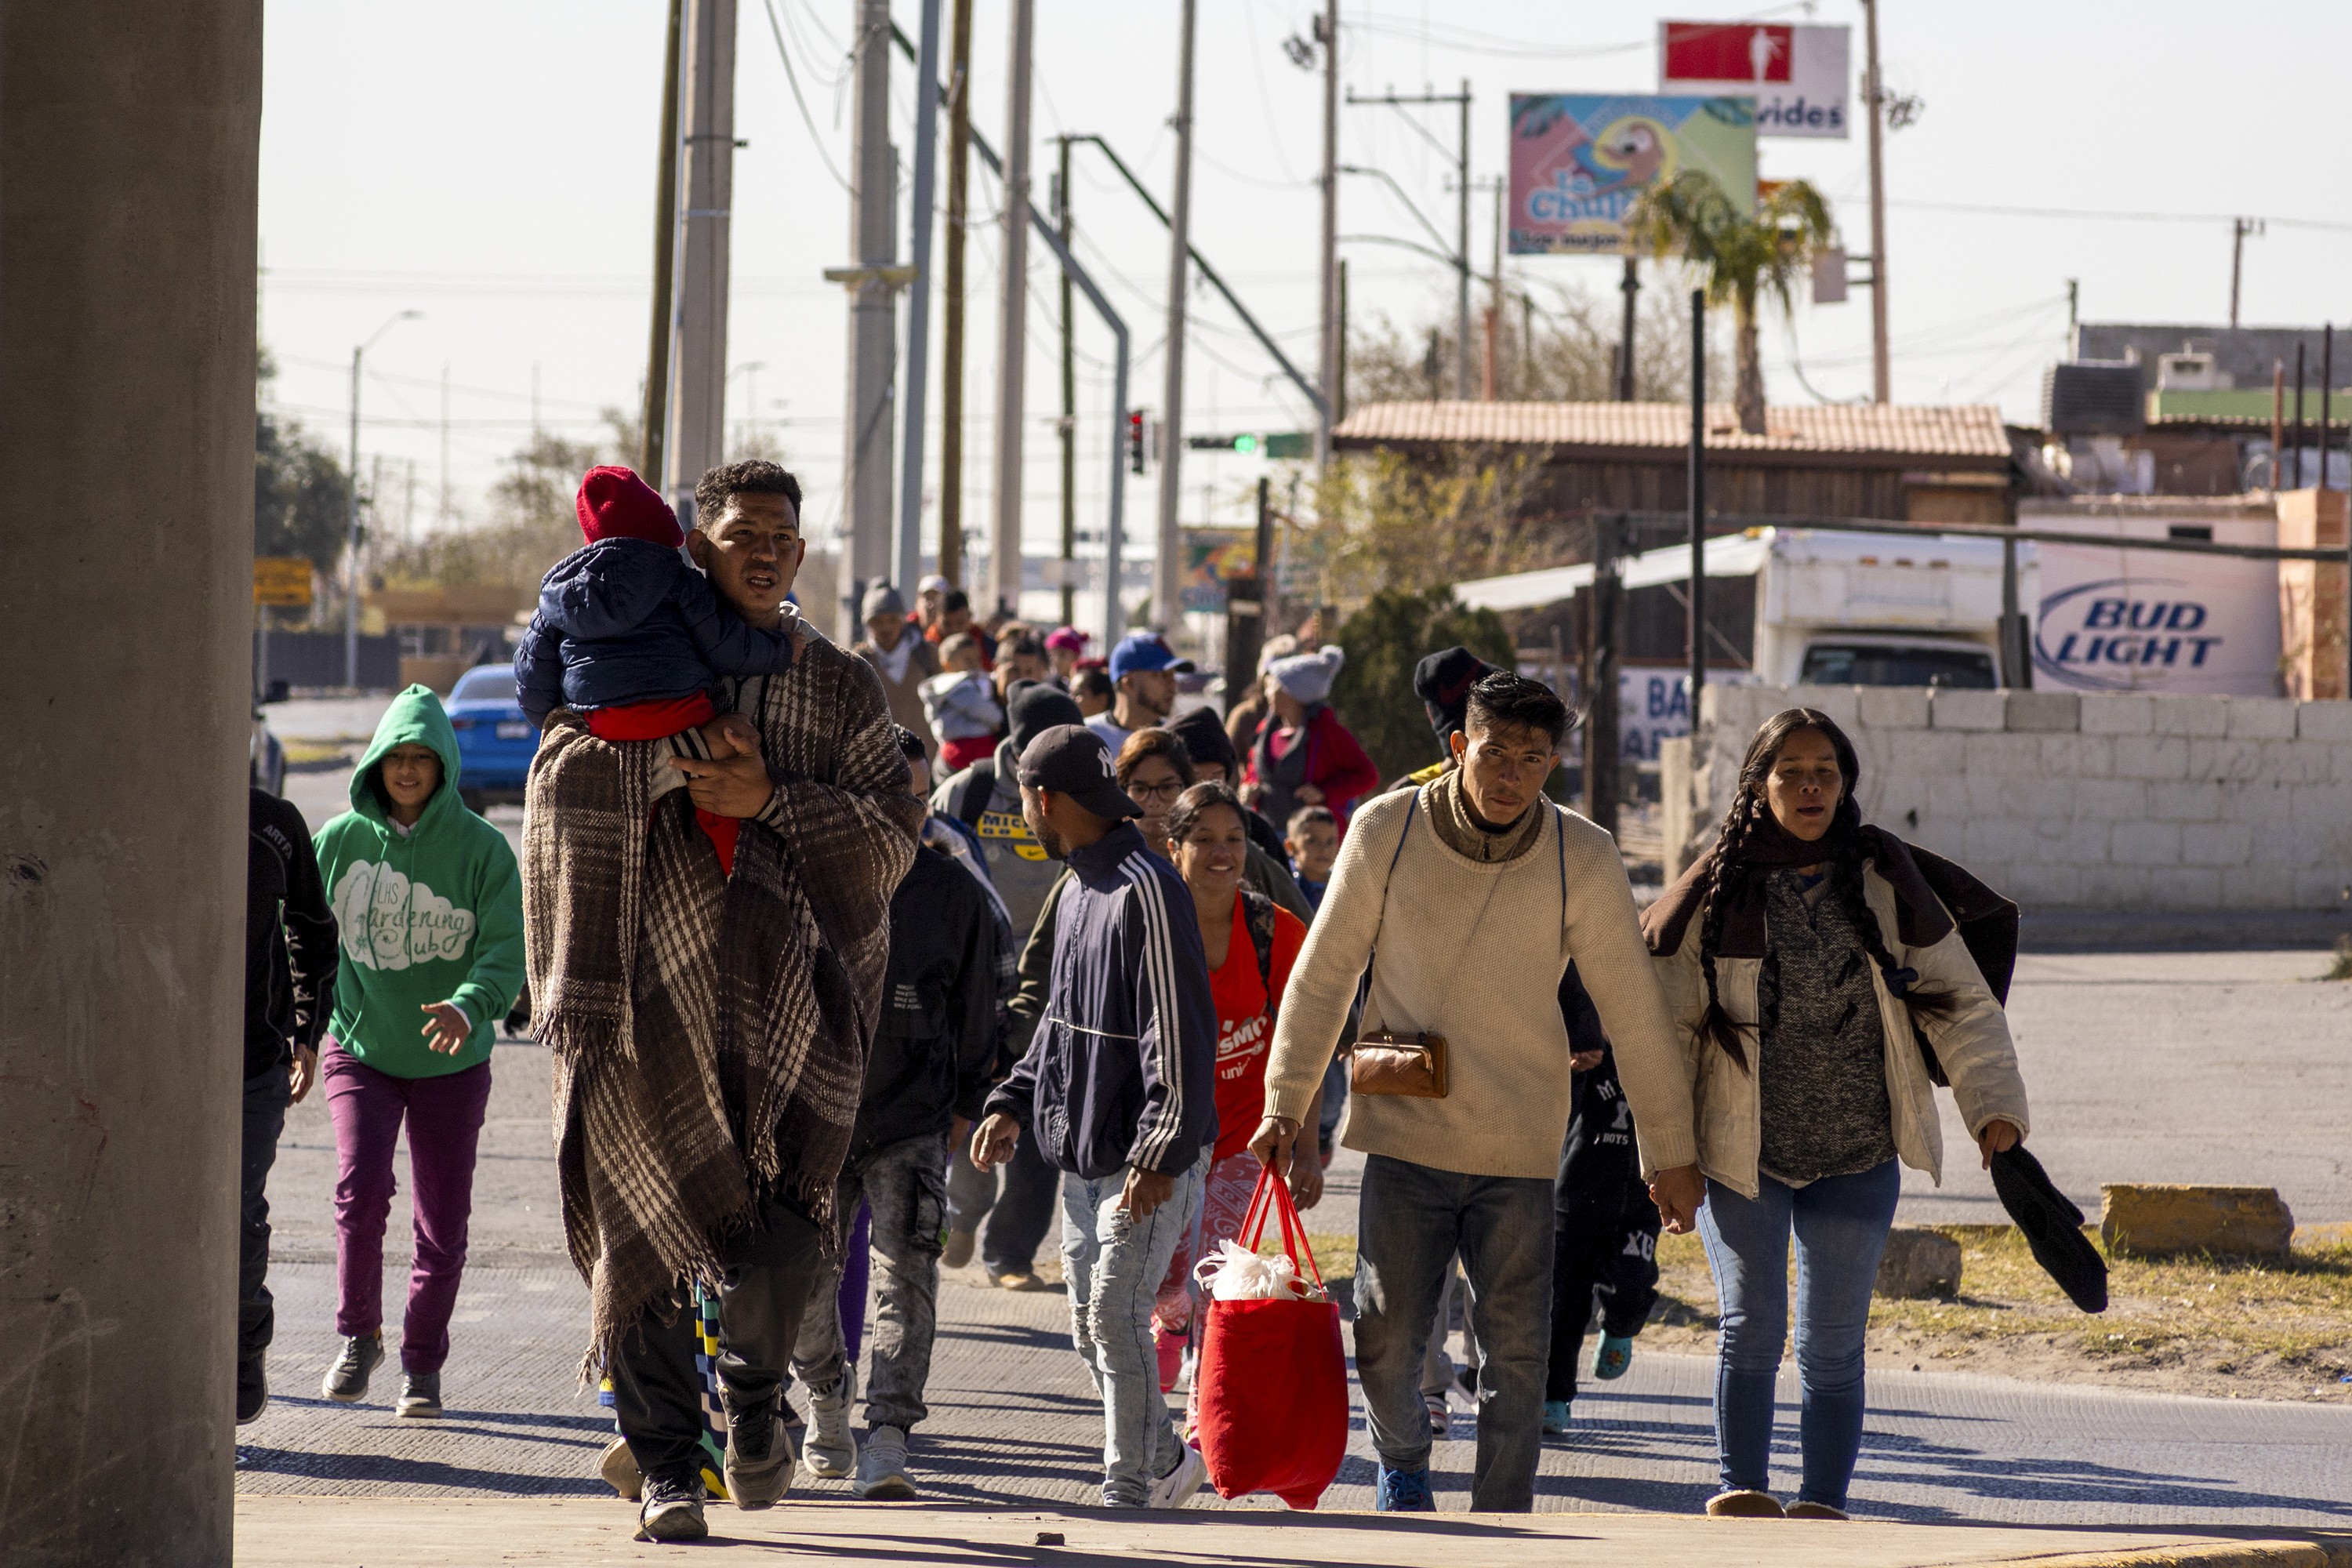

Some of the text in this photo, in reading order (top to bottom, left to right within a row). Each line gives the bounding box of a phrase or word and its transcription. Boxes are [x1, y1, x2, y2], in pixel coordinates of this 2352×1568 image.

[2084, 599, 2209, 630] BUD
[2056, 634, 2223, 668] LIGHT
[983, 815, 1029, 829] MIC
[343, 870, 470, 954] Gardening
[1602, 1133, 1628, 1145] BOYS
